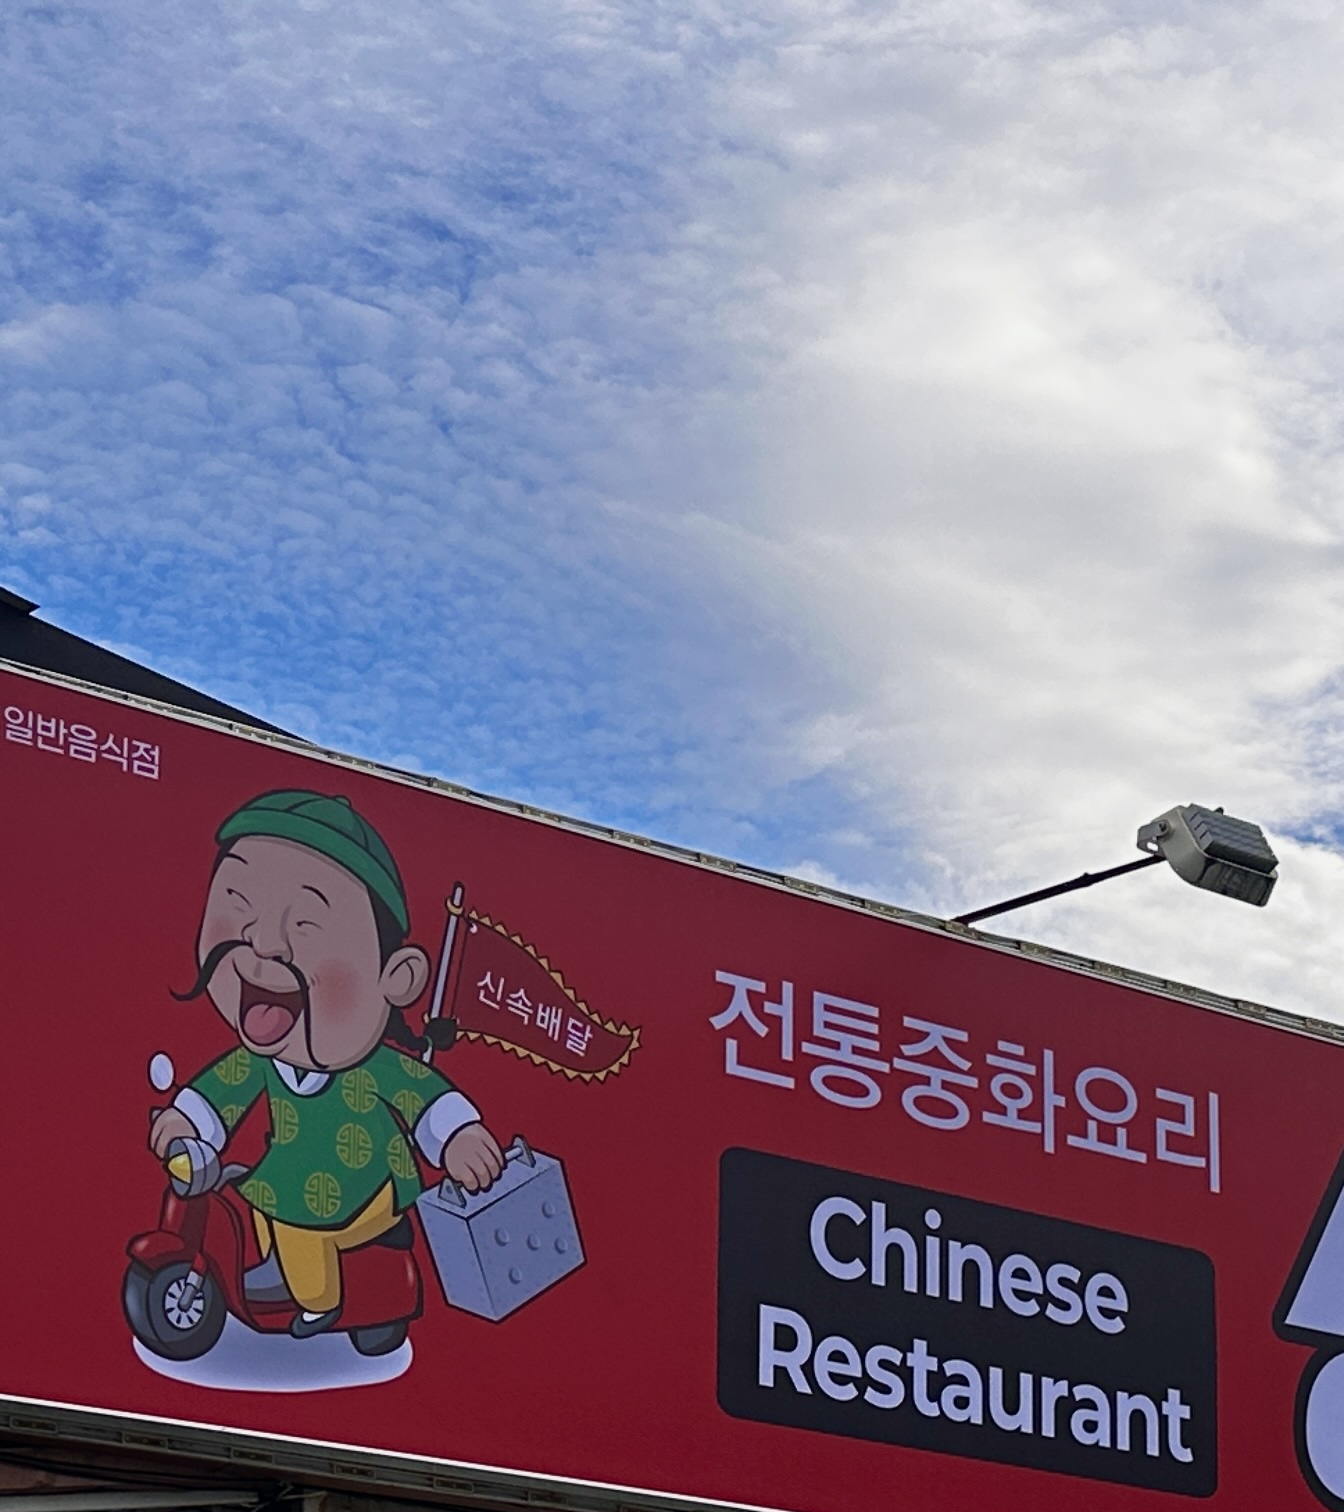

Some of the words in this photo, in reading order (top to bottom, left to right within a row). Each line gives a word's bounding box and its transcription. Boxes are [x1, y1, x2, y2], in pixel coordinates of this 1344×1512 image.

[3, 706, 160, 780] 일반음식점
[476, 970, 594, 1057] 신속배달
[709, 969, 1221, 1193] 전통중화요리
[809, 1195, 1129, 1335] Chinese
[758, 1302, 1193, 1463] Restaurant
